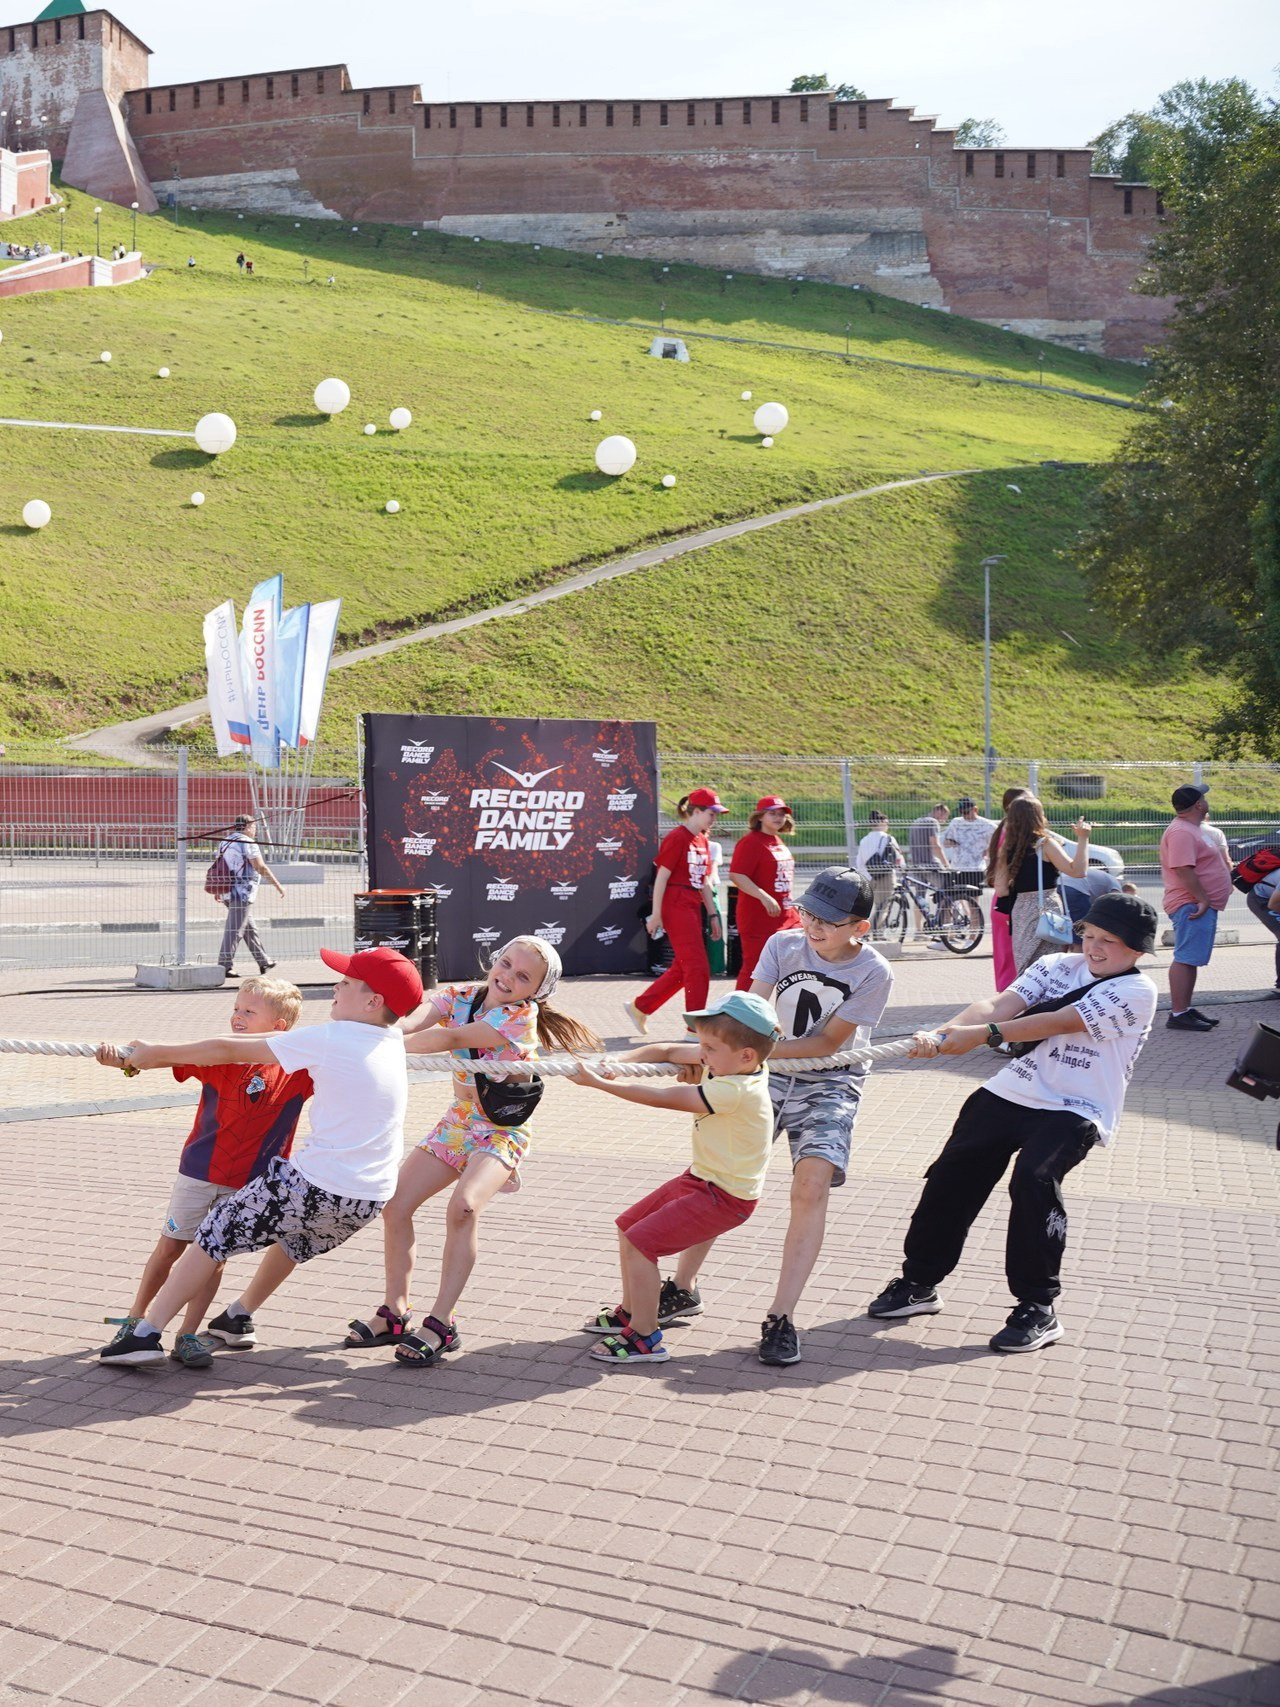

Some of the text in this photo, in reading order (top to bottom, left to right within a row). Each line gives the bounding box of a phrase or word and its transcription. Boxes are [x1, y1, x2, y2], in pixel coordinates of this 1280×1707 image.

[469, 789, 585, 810] RECORD
[478, 810, 575, 830] DANCE
[474, 830, 574, 851] FAMILY
[813, 882, 838, 899] NYC
[789, 972, 818, 983] WEARS
